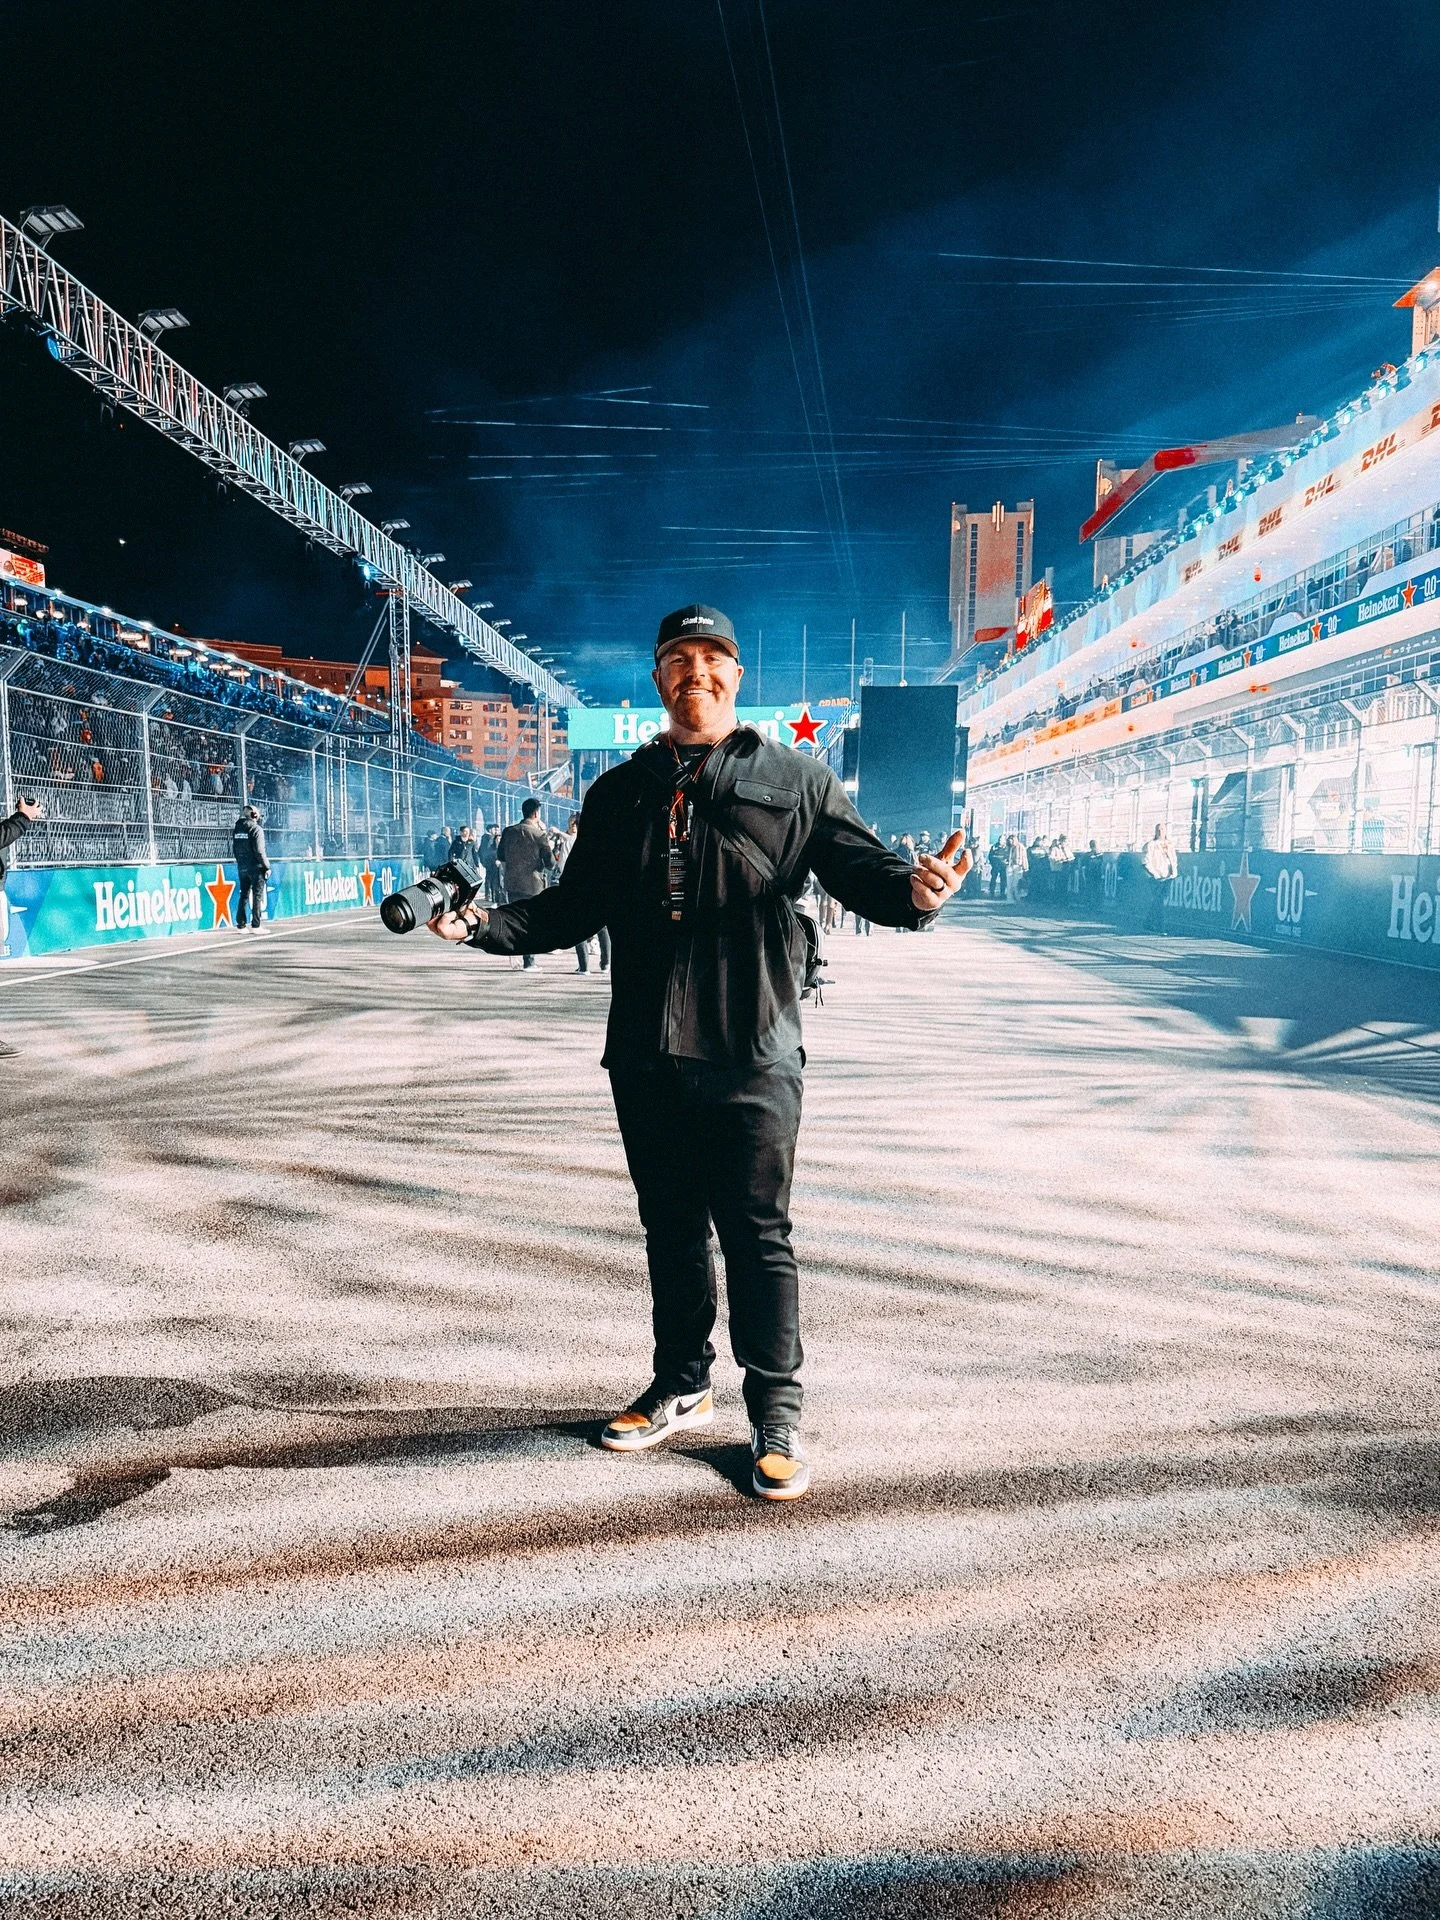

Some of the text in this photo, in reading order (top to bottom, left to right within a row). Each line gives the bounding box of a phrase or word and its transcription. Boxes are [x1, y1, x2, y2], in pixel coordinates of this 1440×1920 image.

[1361, 432, 1397, 472] DHL
[1304, 473, 1334, 507] DHL
[1258, 507, 1282, 536] DHL
[1219, 535, 1239, 561] DHL
[1358, 594, 1399, 622] Heineken
[612, 712, 781, 744] Hein
[304, 870, 358, 905] Heineken
[1276, 869, 1304, 923] 0.0
[94, 879, 202, 931] Heineken
